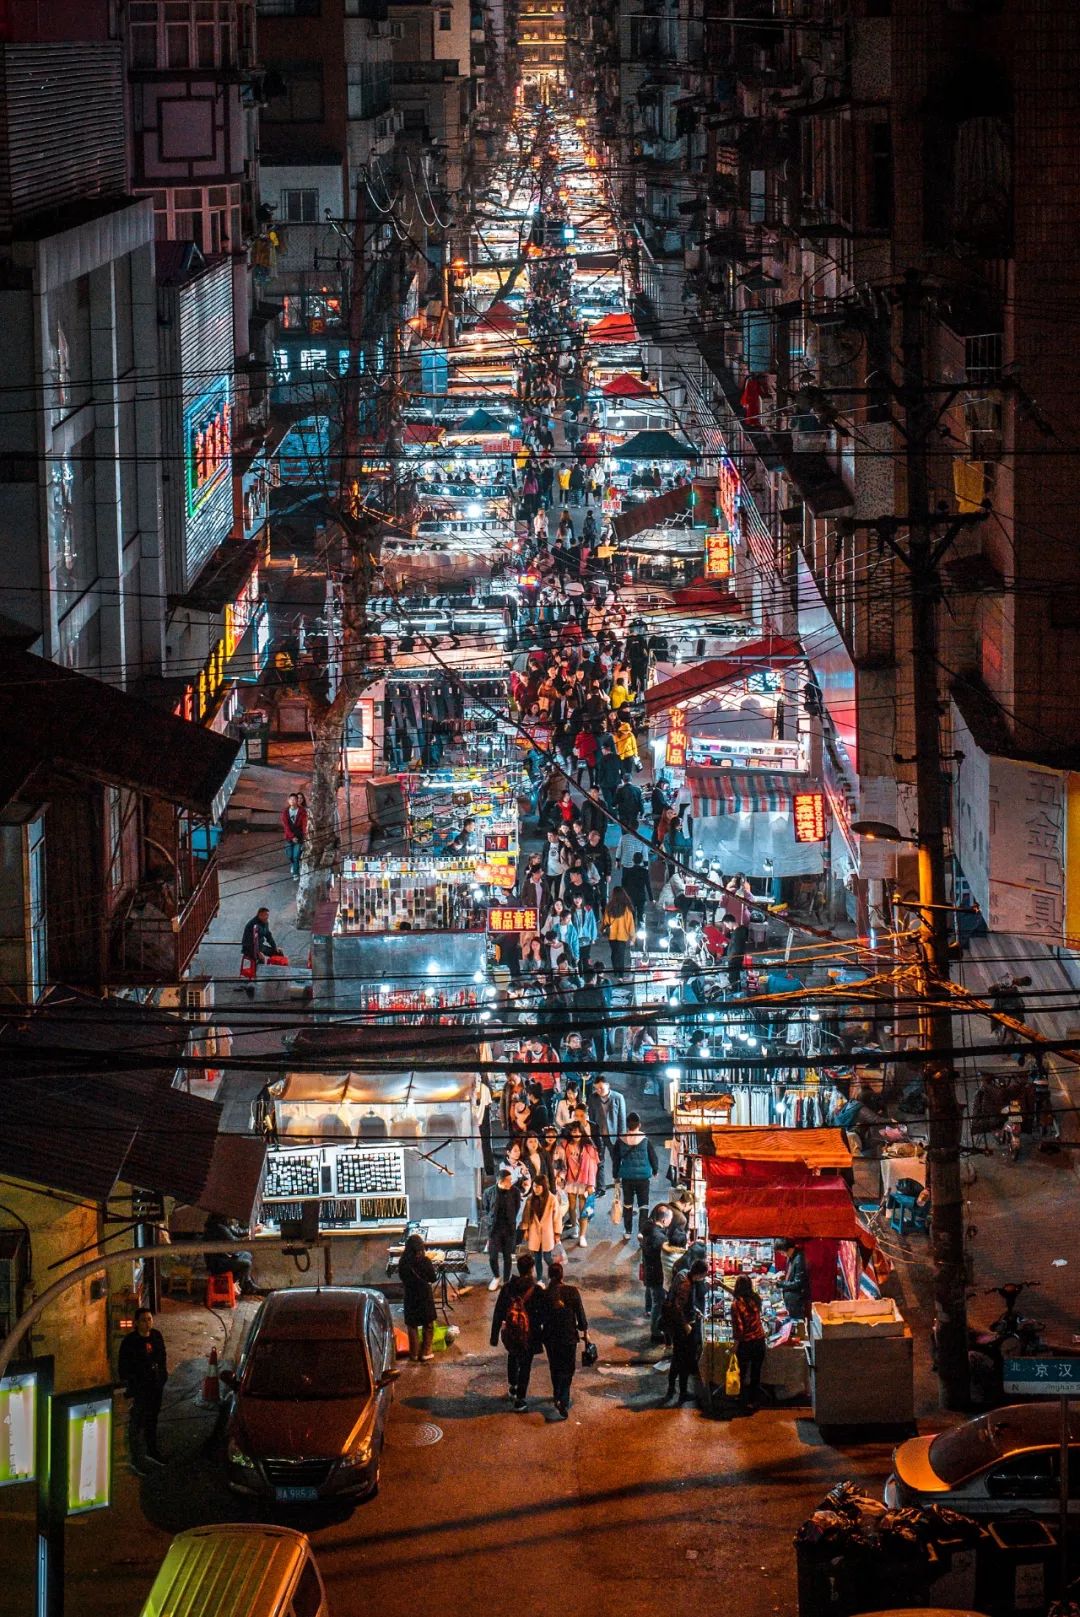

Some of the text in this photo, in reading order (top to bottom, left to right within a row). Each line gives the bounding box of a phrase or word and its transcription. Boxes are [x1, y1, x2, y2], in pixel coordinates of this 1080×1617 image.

[669, 711, 685, 765] 化妆品
[1025, 770, 1062, 934] 五金工具
[491, 910, 536, 930] 精品童鞋
[1035, 1362, 1073, 1378] 京汉
